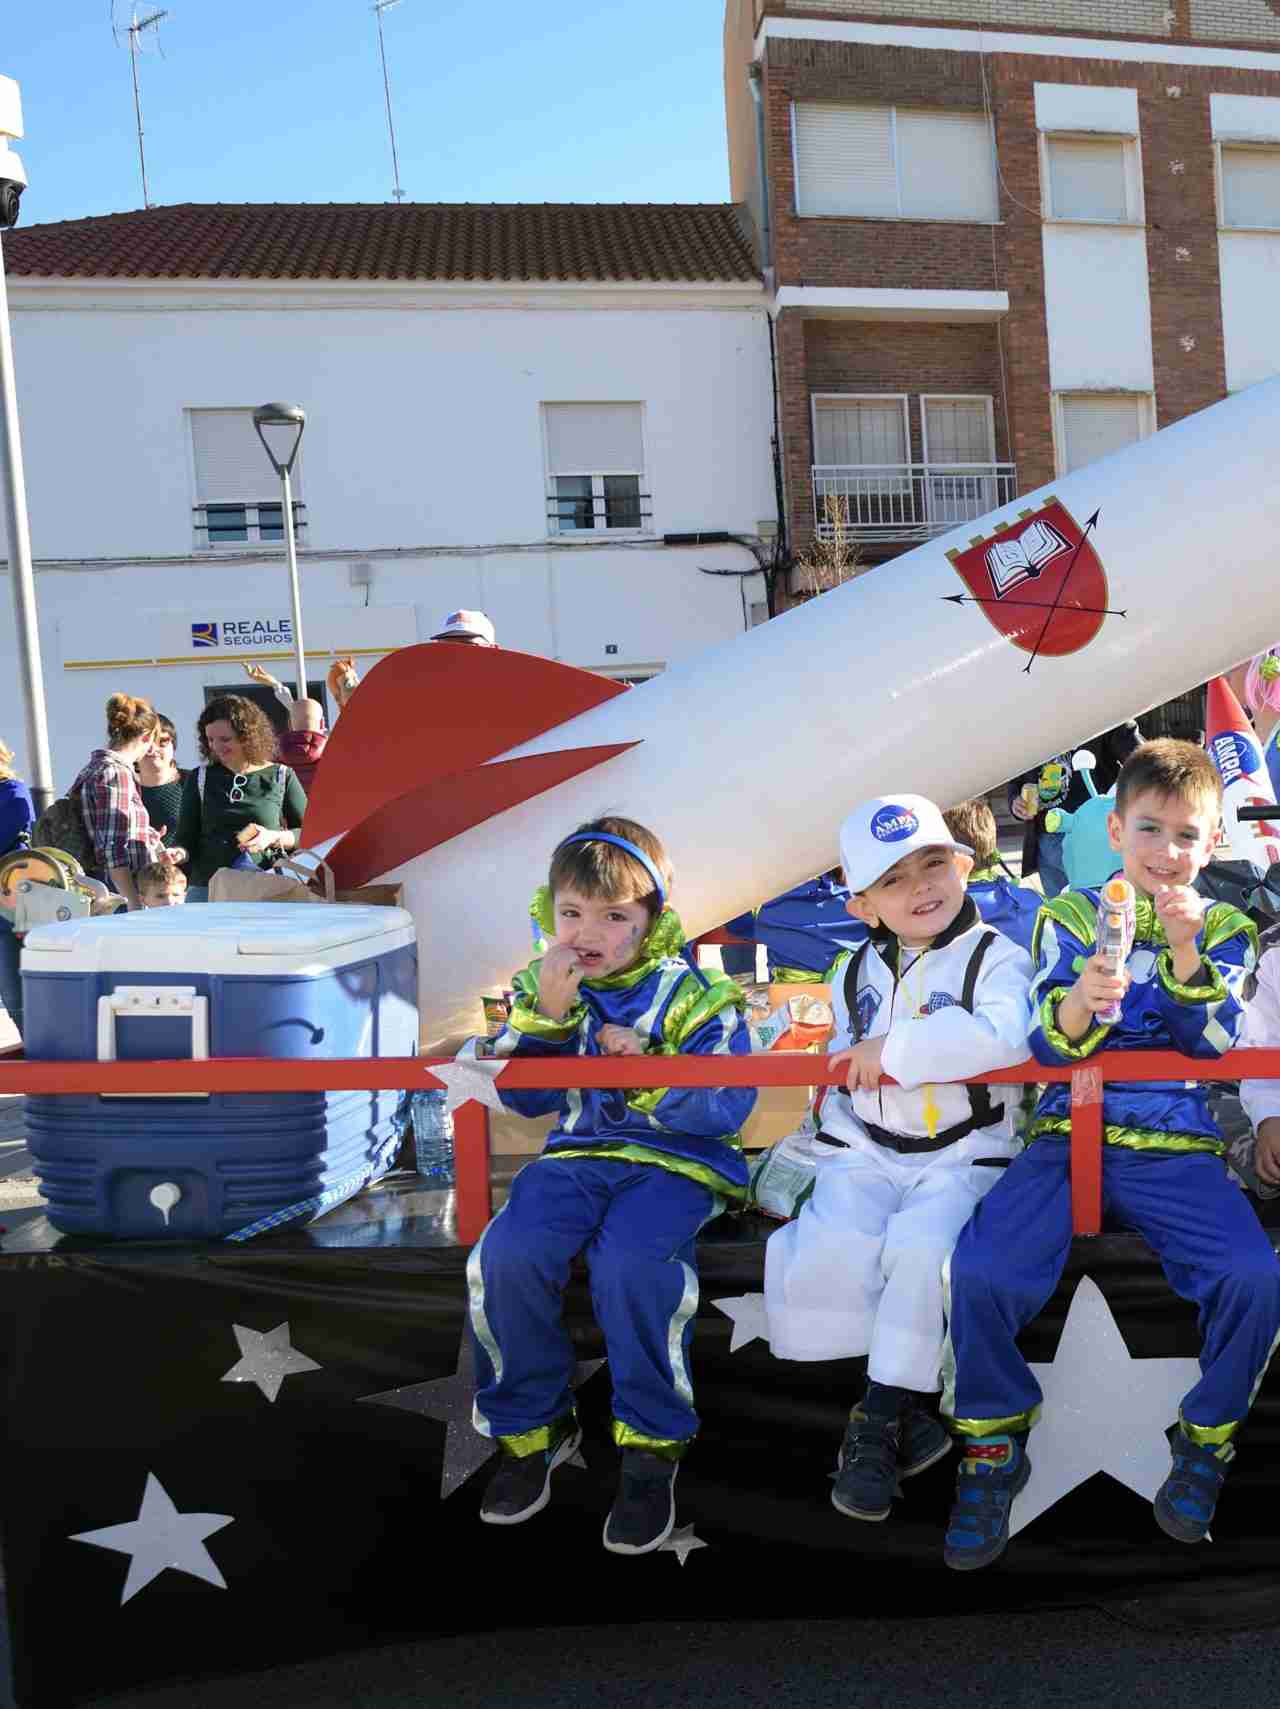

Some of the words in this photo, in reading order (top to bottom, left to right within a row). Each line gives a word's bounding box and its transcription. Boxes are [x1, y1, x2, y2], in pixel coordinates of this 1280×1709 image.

[223, 620, 292, 634] REALE
[223, 634, 293, 646] SEGUROS
[1214, 736, 1242, 784] AMPA
[876, 815, 913, 836] AMPA
